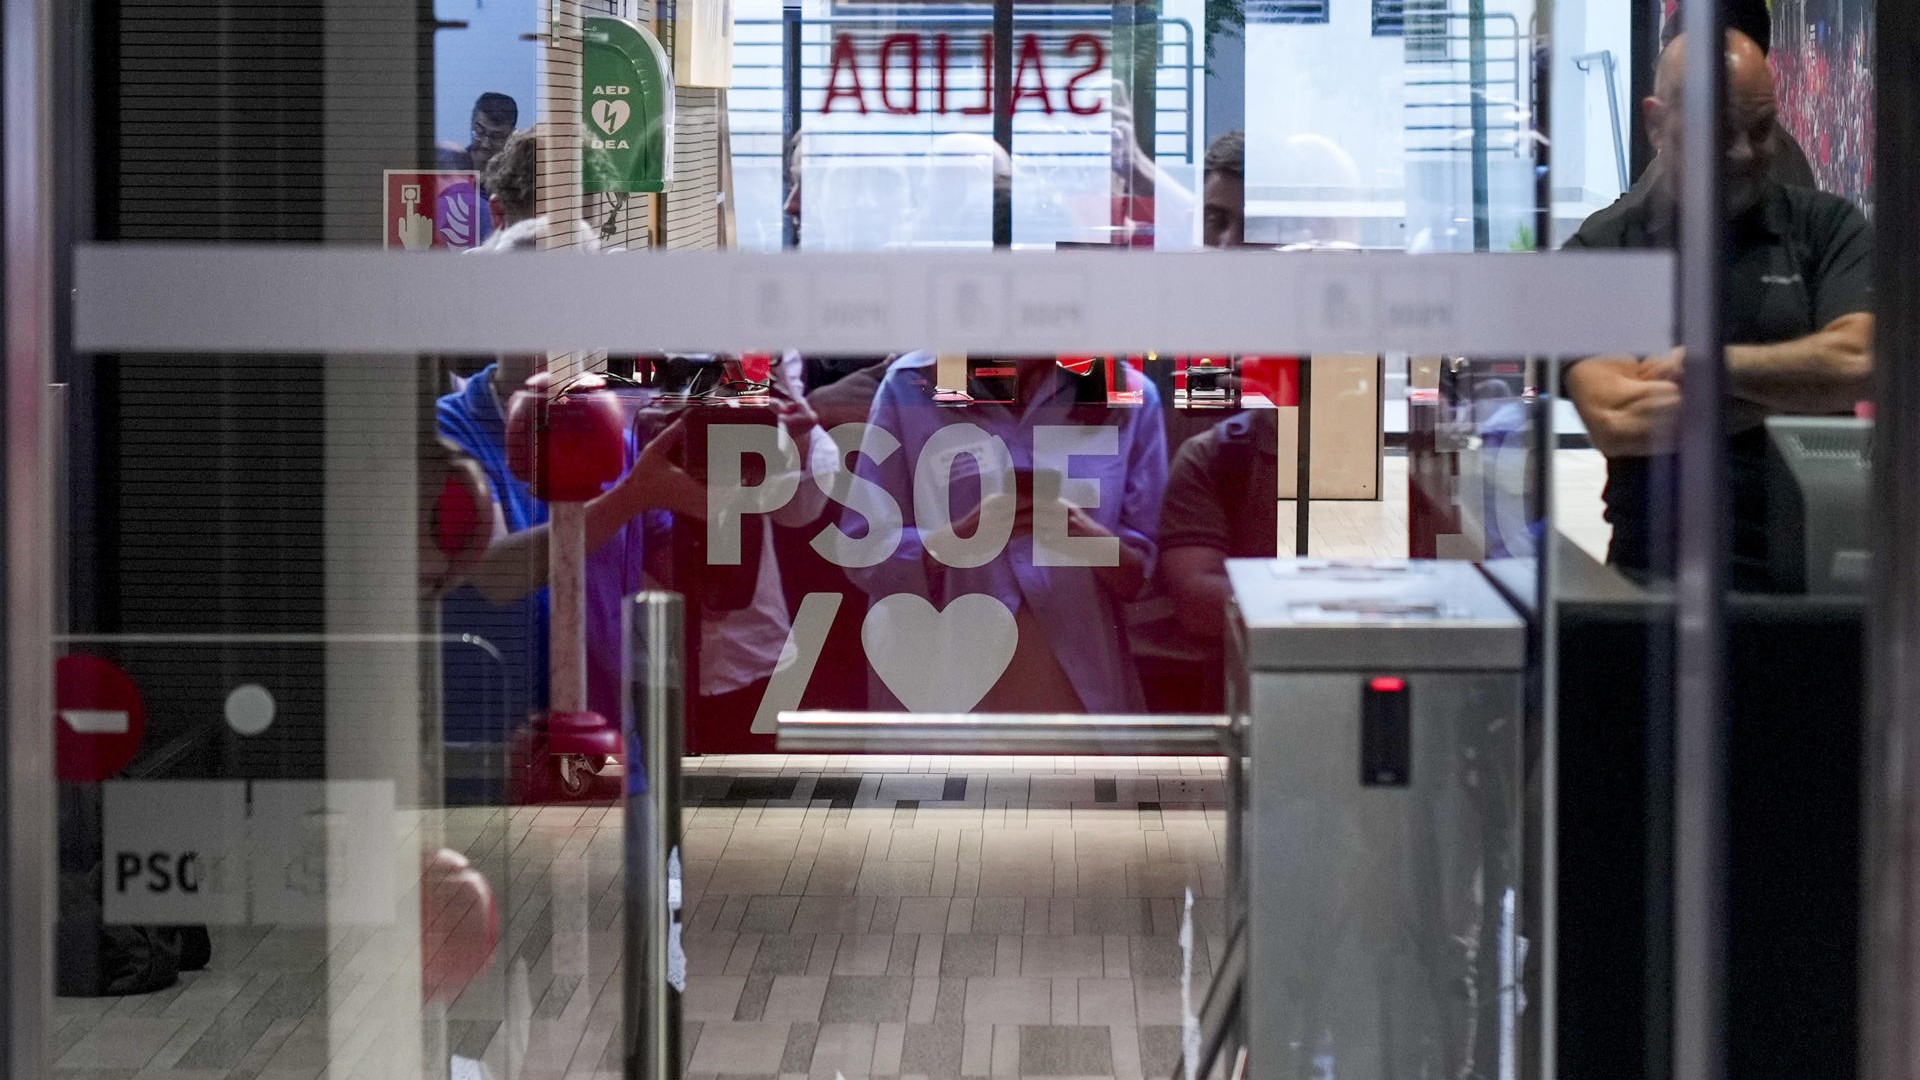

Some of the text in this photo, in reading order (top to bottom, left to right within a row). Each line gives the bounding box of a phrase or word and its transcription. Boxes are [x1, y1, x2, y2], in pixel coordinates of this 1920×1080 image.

[592, 86, 630, 95] AED
[591, 140, 630, 149] DEA
[707, 422, 1120, 568] PSOE
